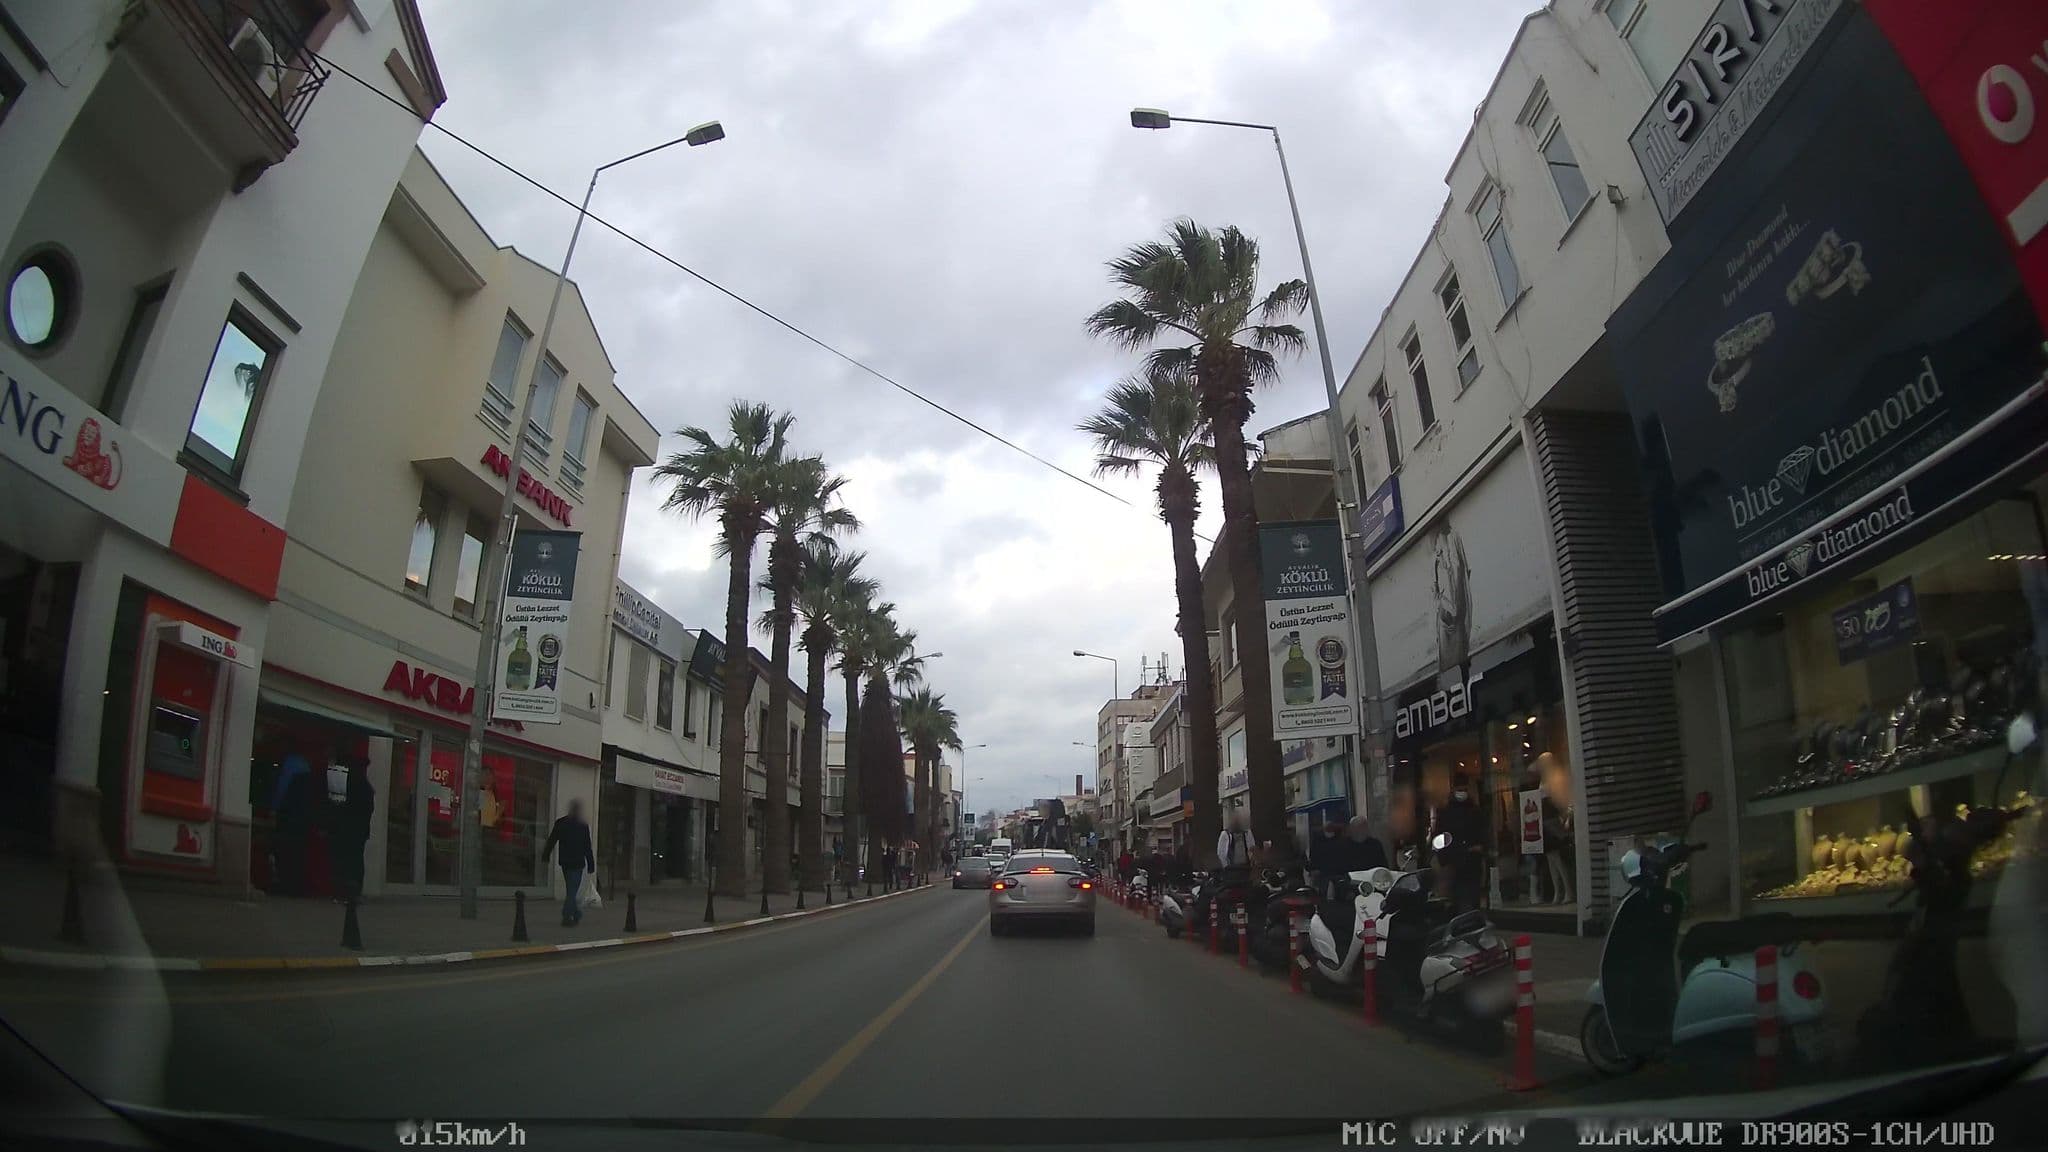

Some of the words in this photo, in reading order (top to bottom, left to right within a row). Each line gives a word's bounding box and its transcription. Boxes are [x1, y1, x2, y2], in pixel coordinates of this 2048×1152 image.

[0, 370, 65, 454] NG
[1728, 478, 1784, 529] blue
[1816, 355, 1943, 475] diamond
[480, 444, 574, 528] AKBANK
[1747, 561, 1790, 597] blue
[1817, 484, 1915, 563] diamond
[1280, 568, 1328, 584] KÖKLÜ
[1270, 619, 1298, 630] Ödüllü
[1301, 613, 1346, 626] Zeytinyağı
[1280, 607, 1305, 617] Üstün
[1307, 603, 1334, 613] Lezzet
[201, 635, 222, 653] ING
